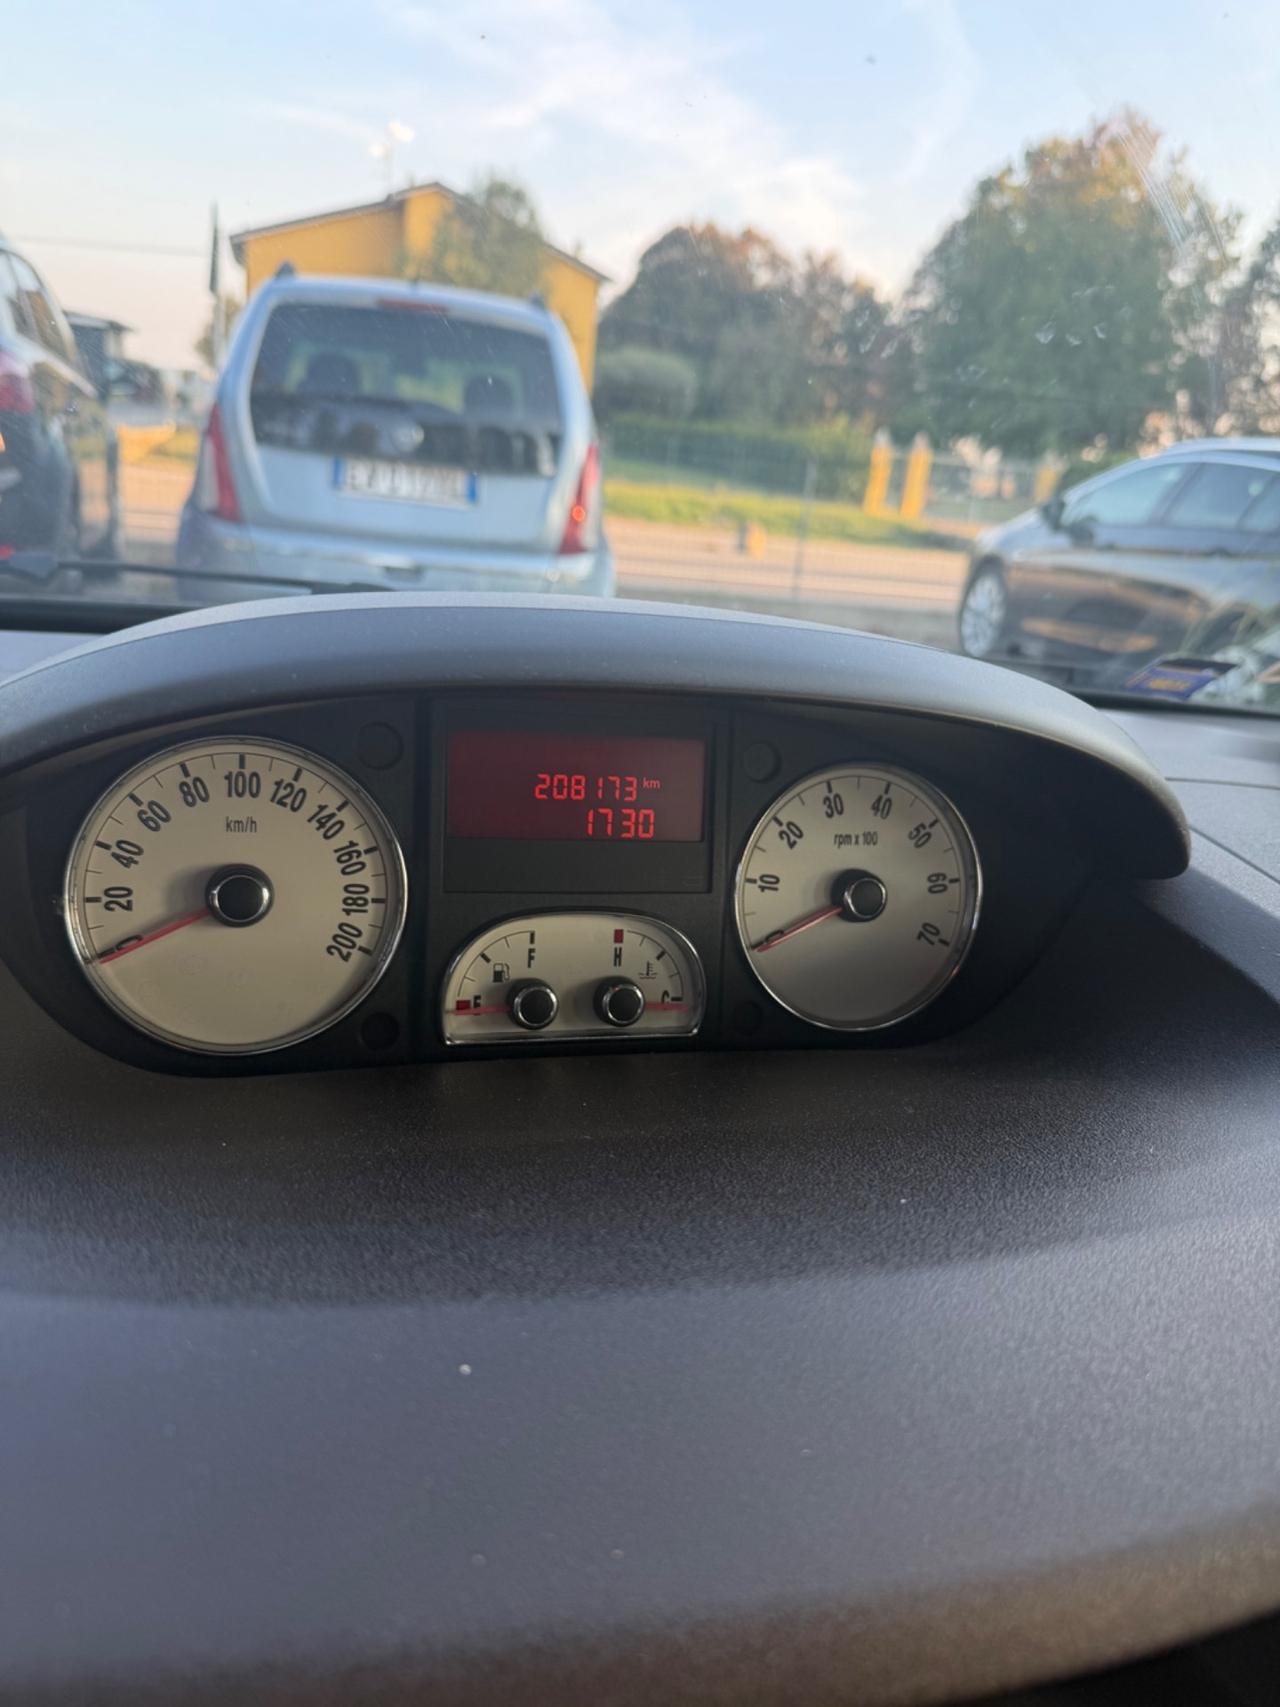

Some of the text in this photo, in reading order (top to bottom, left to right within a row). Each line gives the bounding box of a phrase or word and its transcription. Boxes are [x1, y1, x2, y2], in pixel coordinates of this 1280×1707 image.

[178, 776, 211, 808] 80
[224, 770, 261, 799] 100
[269, 778, 307, 813] 120
[642, 778, 660, 789] km
[137, 799, 172, 832] 60
[823, 794, 844, 818] 30
[871, 796, 892, 819] 40
[225, 816, 257, 834] km/h
[306, 803, 345, 841] 140
[779, 821, 804, 849] 20
[833, 833, 853, 849] rpm
[862, 831, 878, 846] 100
[908, 823, 932, 848] 50
[110, 838, 145, 869] 40
[333, 840, 367, 876] 160
[758, 874, 780, 892] 10
[927, 872, 949, 895] 60
[103, 885, 134, 912] 20
[341, 883, 370, 917] 180
[326, 921, 363, 963] 200
[917, 922, 940, 945] 70
[527, 948, 536, 968] F
[613, 946, 622, 967] H
